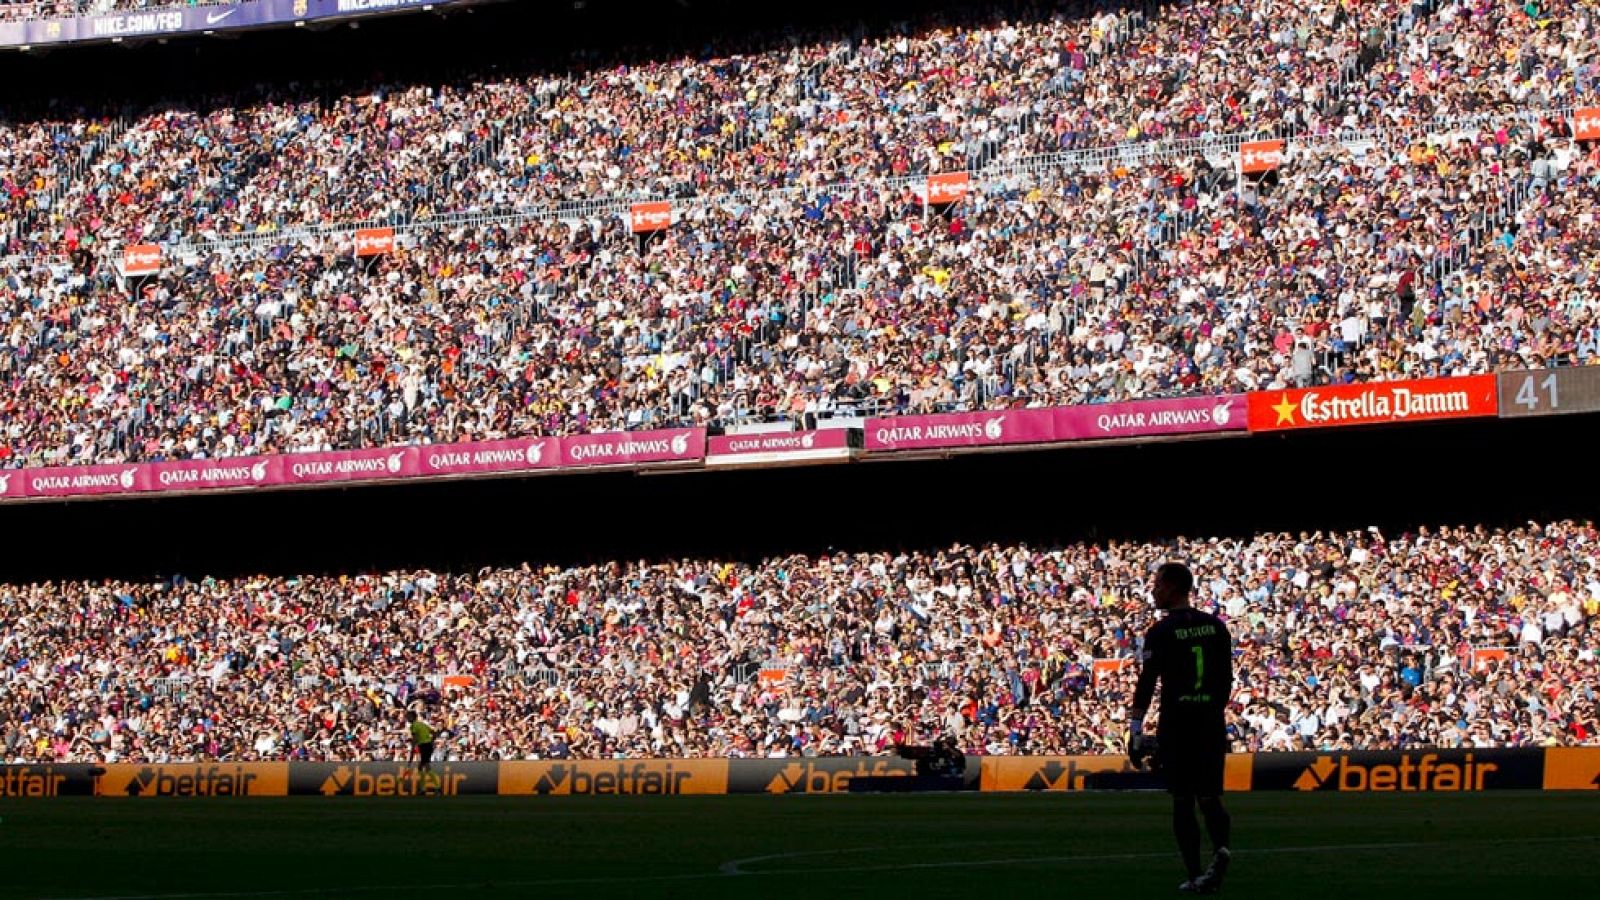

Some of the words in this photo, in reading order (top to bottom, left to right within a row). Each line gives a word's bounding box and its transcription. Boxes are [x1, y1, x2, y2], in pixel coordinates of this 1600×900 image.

[94, 12, 182, 35] NIKE.COM/FCB
[1515, 373, 1558, 409] 41
[1301, 391, 1389, 420] Estrella
[1392, 388, 1468, 417] Damm
[1098, 413, 1146, 431] QATAR
[1148, 408, 1210, 426] AIRWAYS
[730, 440, 760, 451] QATAR
[762, 437, 801, 448] AIRWAYS
[877, 426, 921, 444] QATAR
[924, 423, 982, 439] AIRWAYS
[429, 453, 470, 469] QATAR
[473, 449, 524, 464] AIRWAYS
[570, 444, 612, 460] QATAR
[615, 439, 669, 455] AIRWAYS
[160, 470, 198, 485] QATAR
[200, 467, 250, 480] AIRWAYS
[292, 462, 332, 477] QATAR
[335, 457, 385, 472] AIRWAYS
[32, 477, 69, 491] QATAR
[71, 474, 118, 487] AIRWAYS
[1191, 645, 1205, 689] 1
[0, 767, 66, 796] tfair
[157, 767, 257, 796] betfair
[353, 765, 467, 796] betfair
[570, 763, 691, 794] betfair
[1338, 752, 1498, 792] betfair
